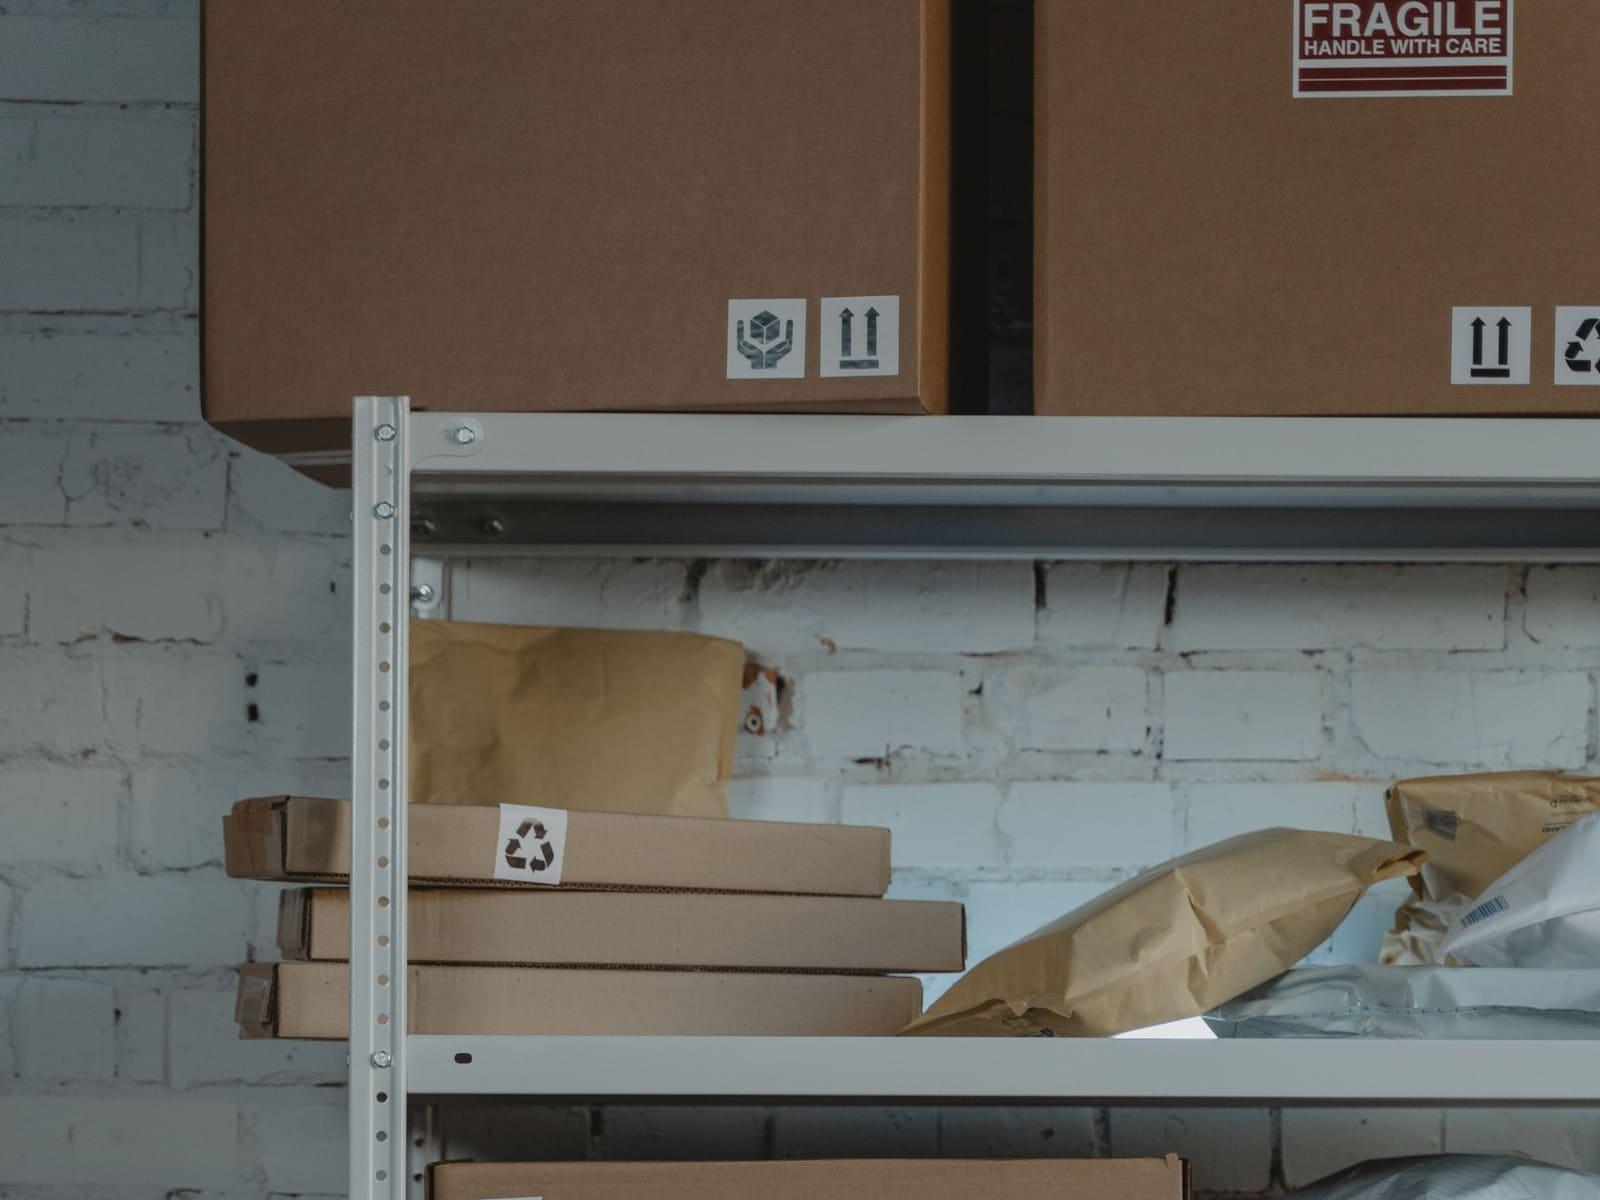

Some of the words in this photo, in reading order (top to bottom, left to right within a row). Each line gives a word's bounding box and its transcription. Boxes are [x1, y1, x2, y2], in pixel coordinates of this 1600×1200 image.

[1305, 1, 1501, 37] FRAGILE
[1305, 40, 1384, 55] HANDLE
[1391, 39, 1439, 54] WITH
[1446, 38, 1500, 53] CARE
